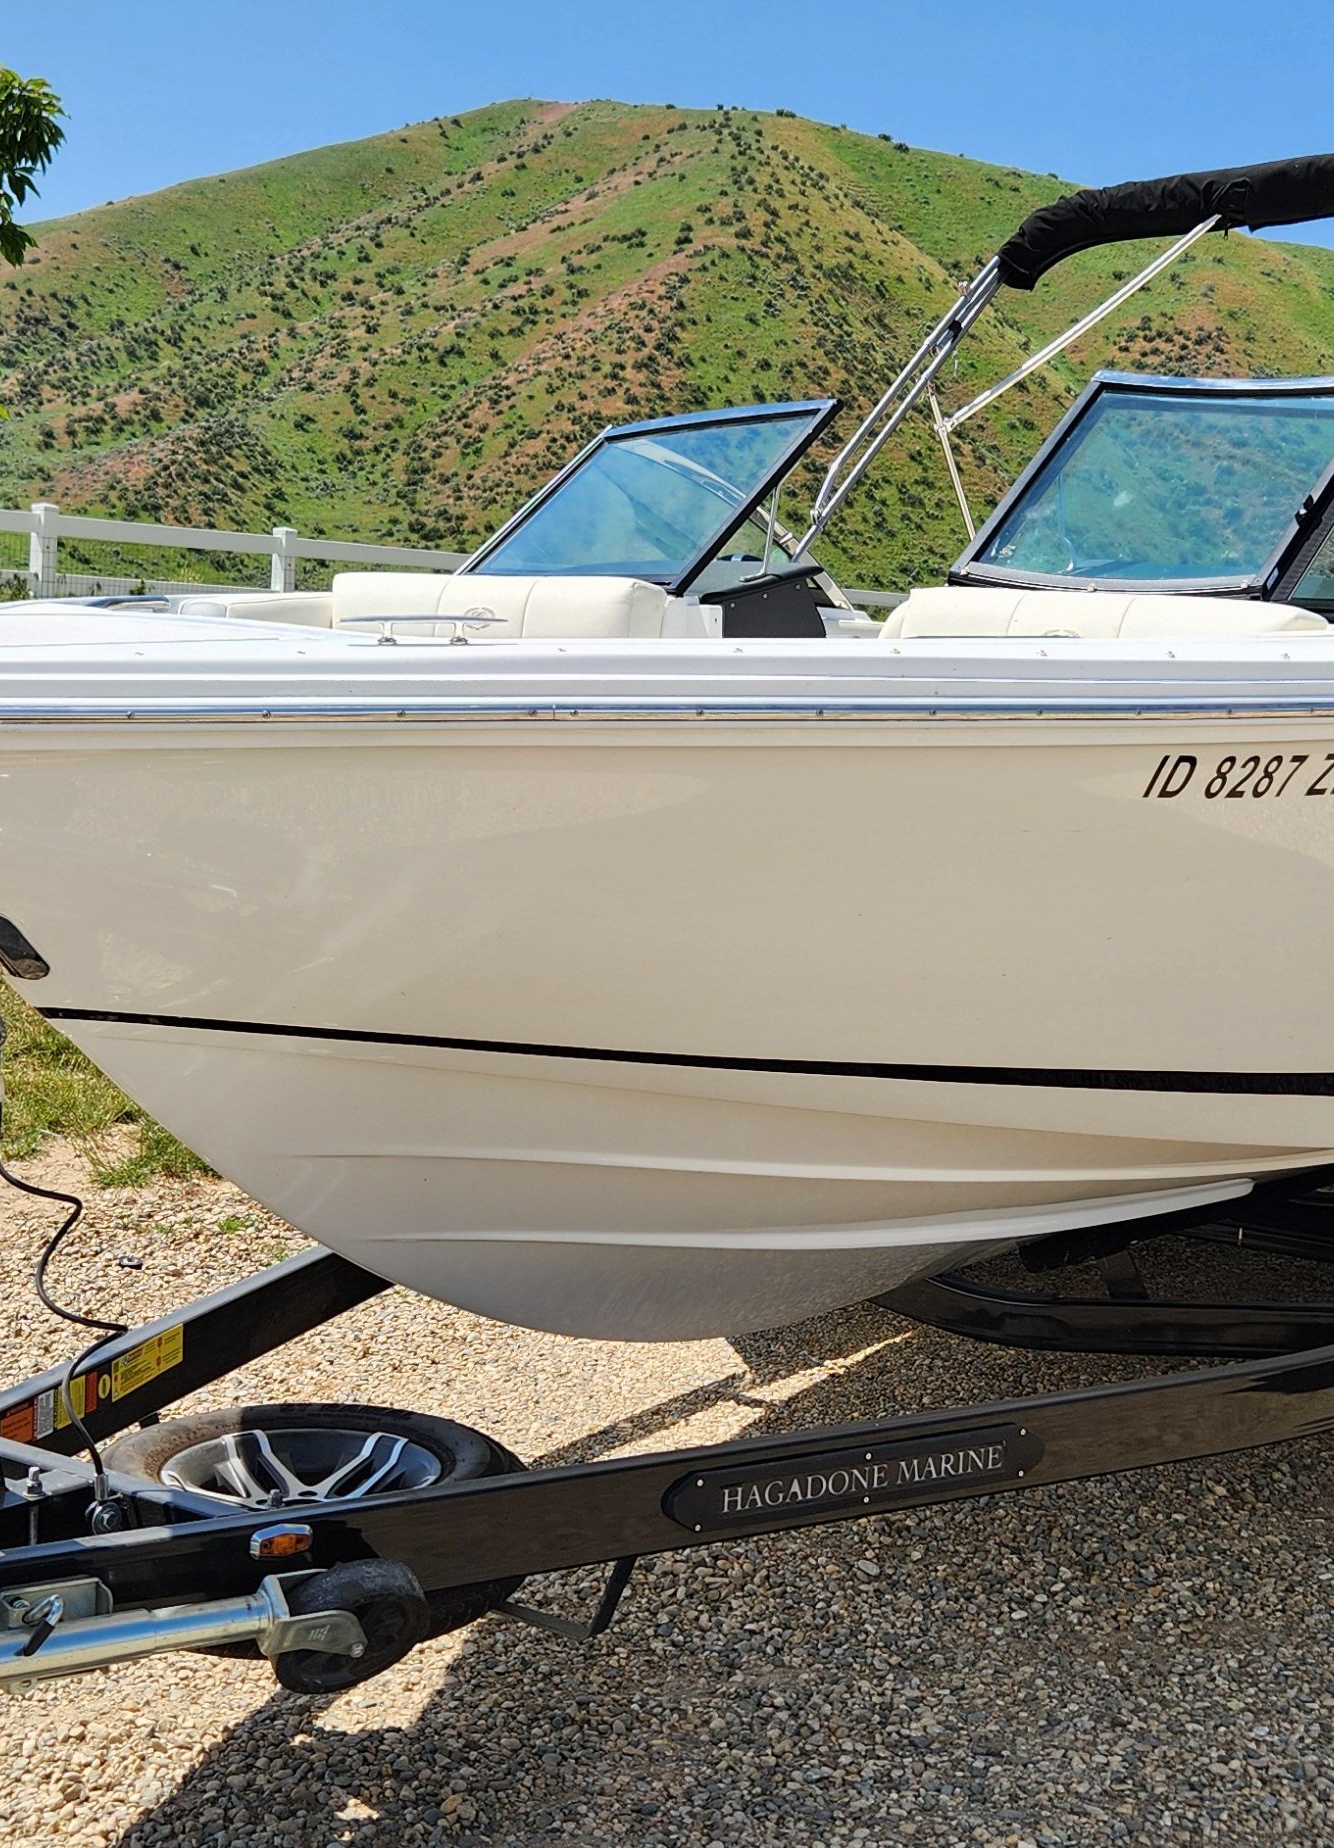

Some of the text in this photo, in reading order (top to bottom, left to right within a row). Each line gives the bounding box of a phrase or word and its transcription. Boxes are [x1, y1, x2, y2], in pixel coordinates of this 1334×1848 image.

[1142, 755, 1198, 798] ID
[1204, 754, 1310, 799] 8287
[721, 1444, 1005, 1514] HAGADONE MARINE
